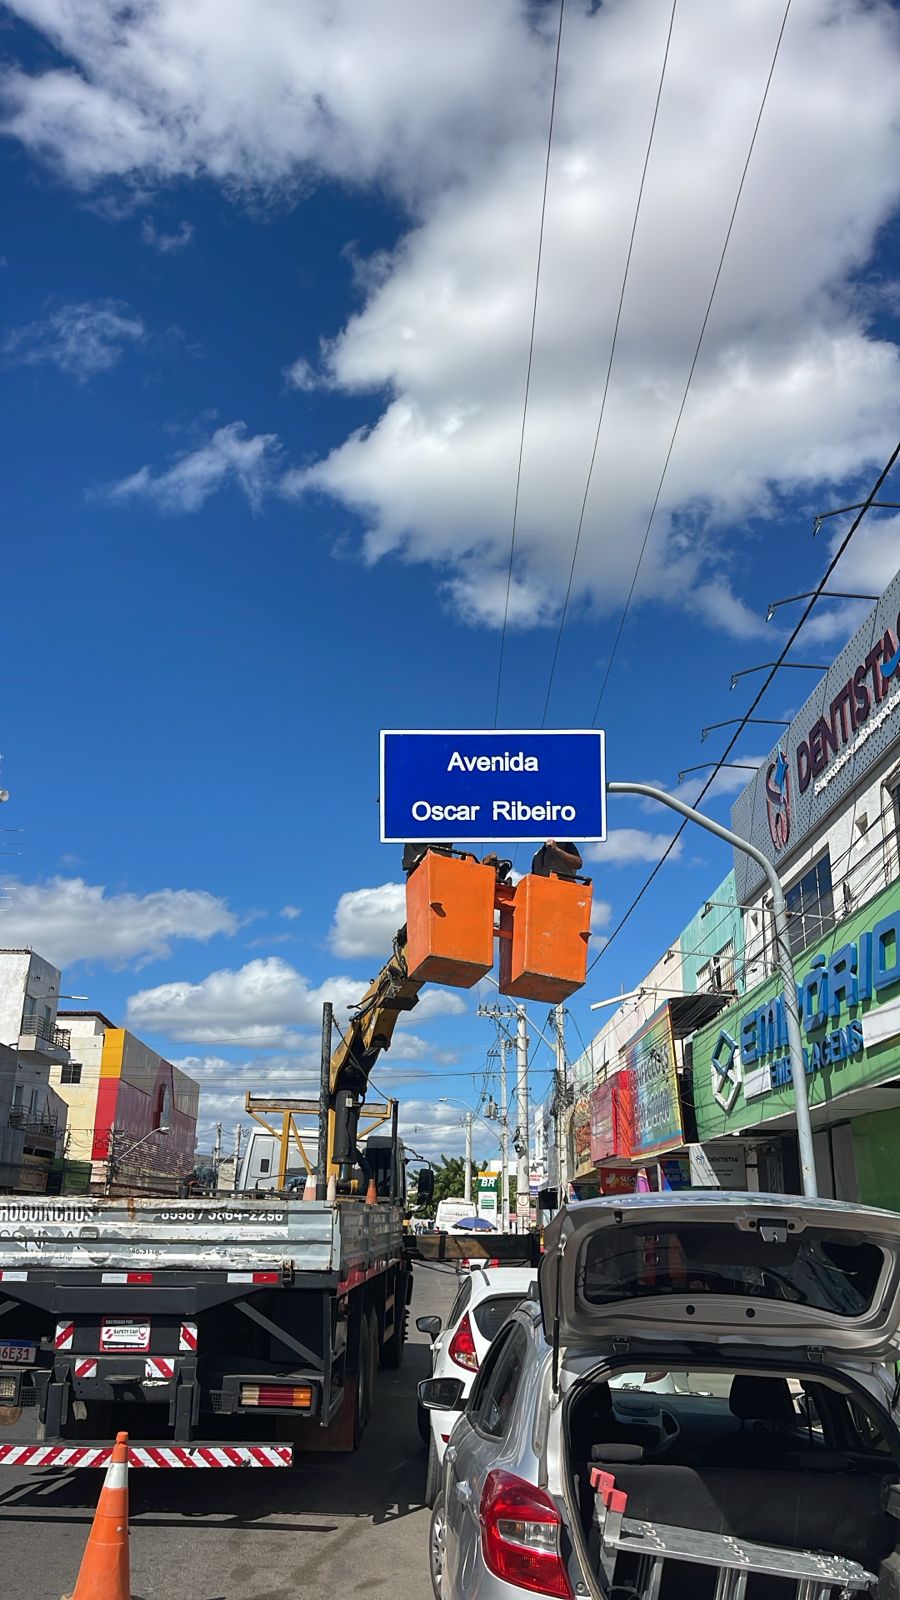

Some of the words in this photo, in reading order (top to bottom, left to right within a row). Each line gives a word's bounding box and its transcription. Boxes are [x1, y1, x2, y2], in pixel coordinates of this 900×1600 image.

[796, 613, 900, 794] DENTISTA
[447, 752, 539, 772] Avenida
[411, 801, 480, 821] Oscar
[492, 801, 577, 821] Ribeiro
[770, 1019, 864, 1088] EMBLAGENS
[481, 1178, 496, 1188] BR
